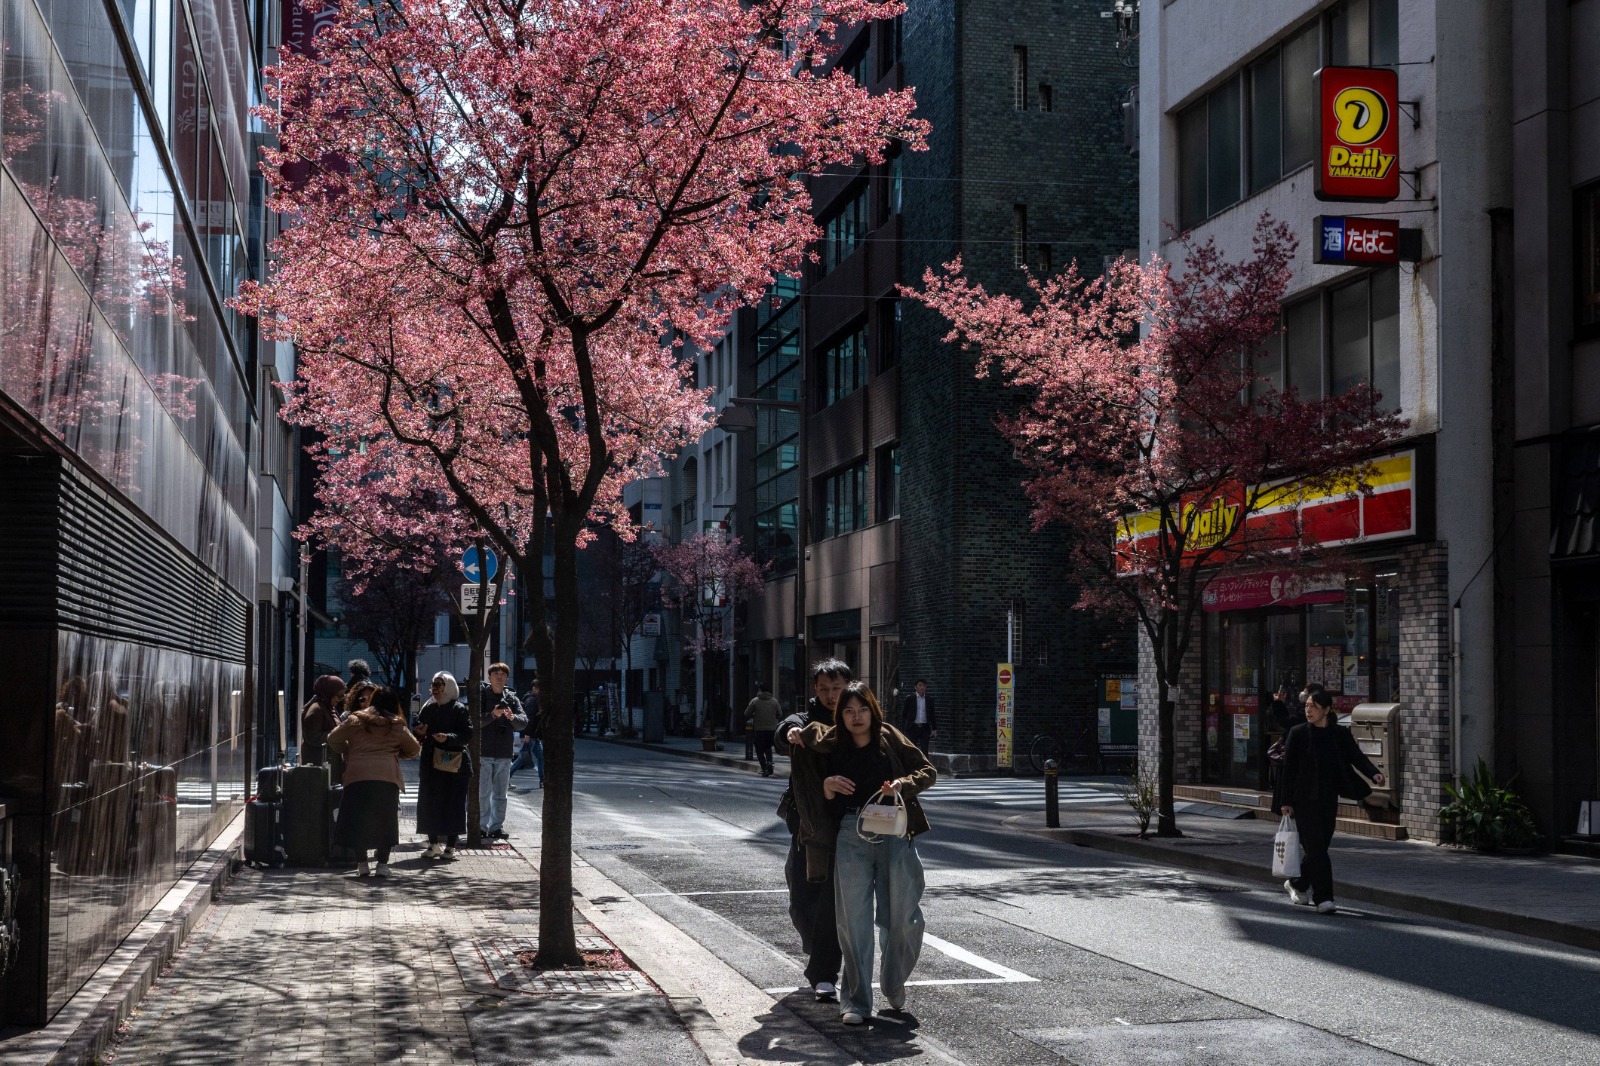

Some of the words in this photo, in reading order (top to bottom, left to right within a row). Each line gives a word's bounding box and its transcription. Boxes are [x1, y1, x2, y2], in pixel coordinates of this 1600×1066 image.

[1330, 146, 1394, 178] Daily
[1330, 166, 1376, 177] YAMAZAKI
[1323, 227, 1343, 252] 酒
[1346, 228, 1394, 254] たばこ
[463, 596, 495, 604] 一方行
